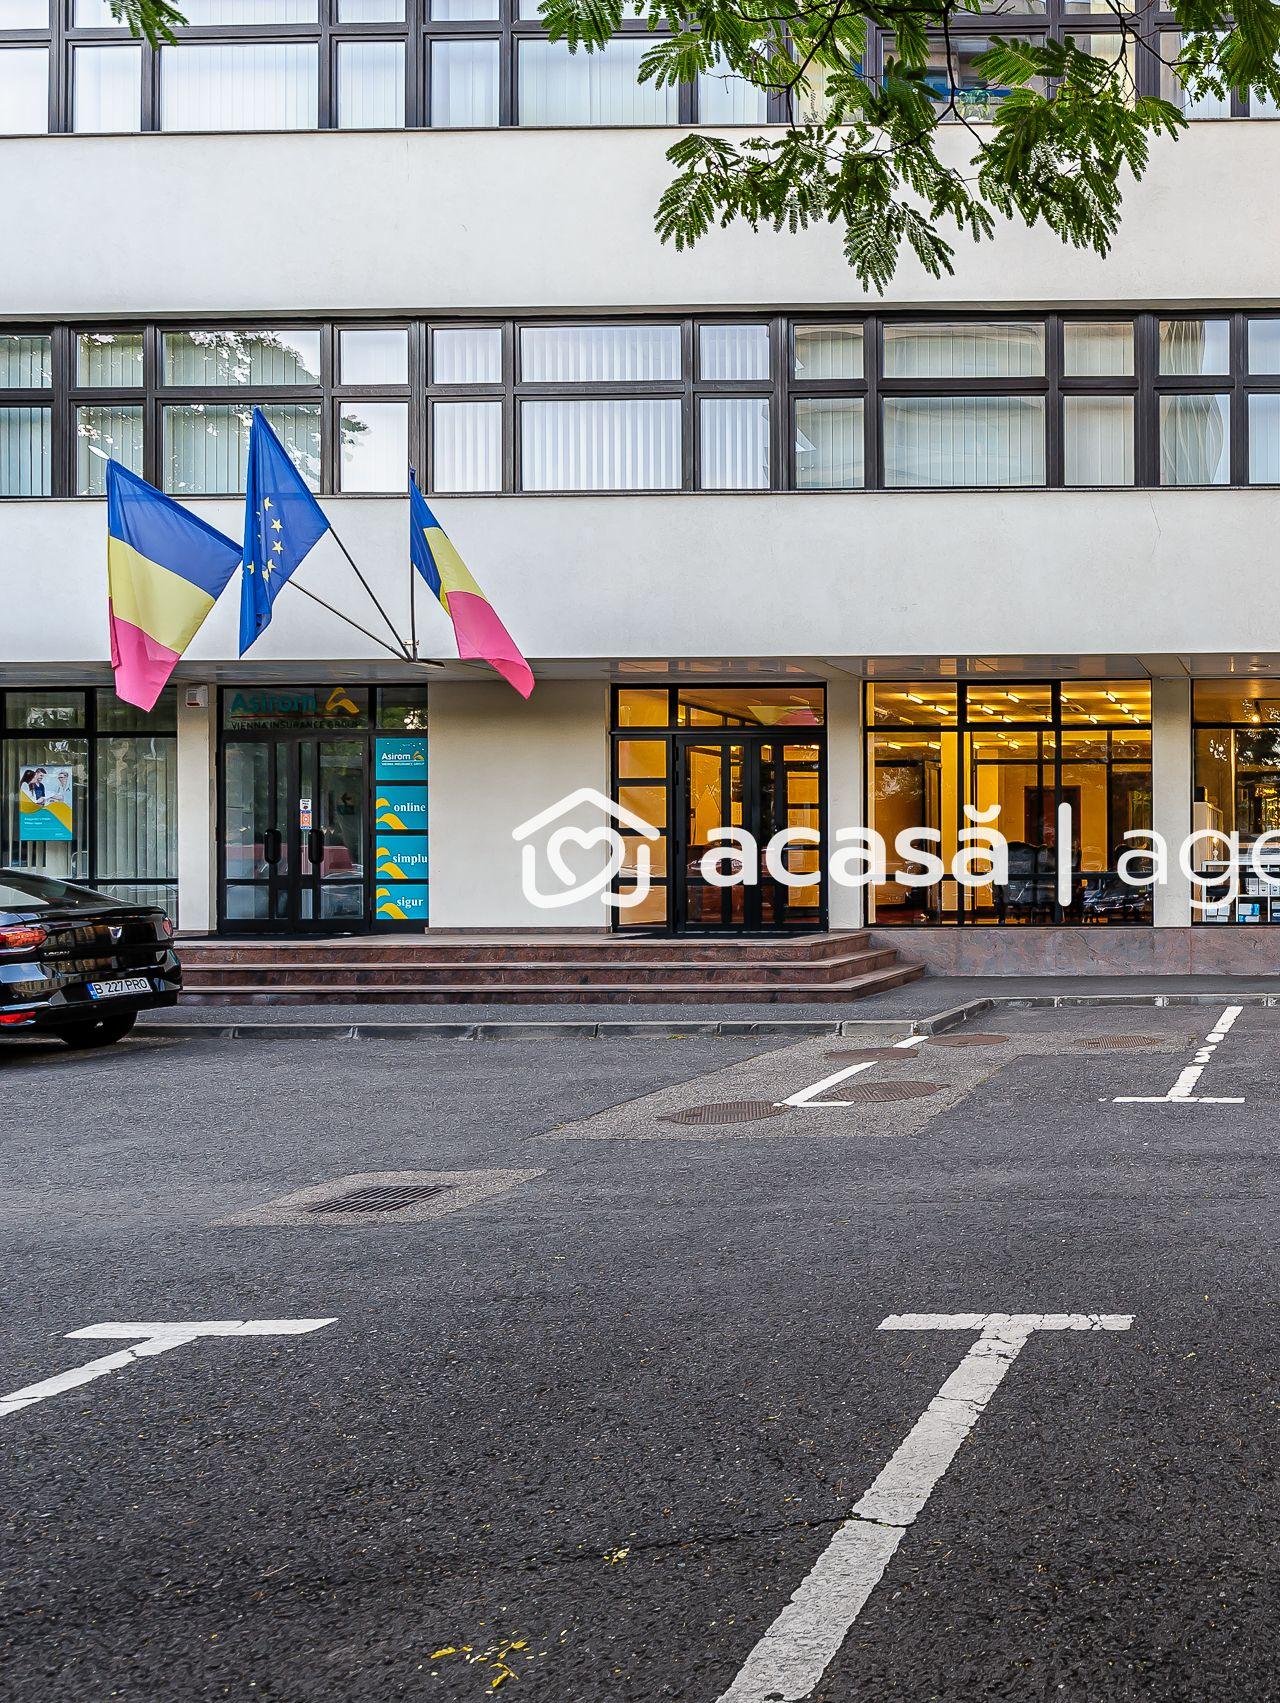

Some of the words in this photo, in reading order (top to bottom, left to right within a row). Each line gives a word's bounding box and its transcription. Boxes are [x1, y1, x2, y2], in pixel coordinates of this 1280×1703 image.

[230, 692, 318, 713] Asirom
[231, 720, 267, 730] VIENNA
[270, 719, 325, 730] INSURANCE
[381, 752, 411, 760] Asirom
[393, 802, 426, 812] online
[392, 853, 428, 866] simplu
[396, 896, 424, 909] sigur
[94, 983, 104, 995] B
[105, 981, 123, 993] 227
[125, 978, 148, 991] PRO
